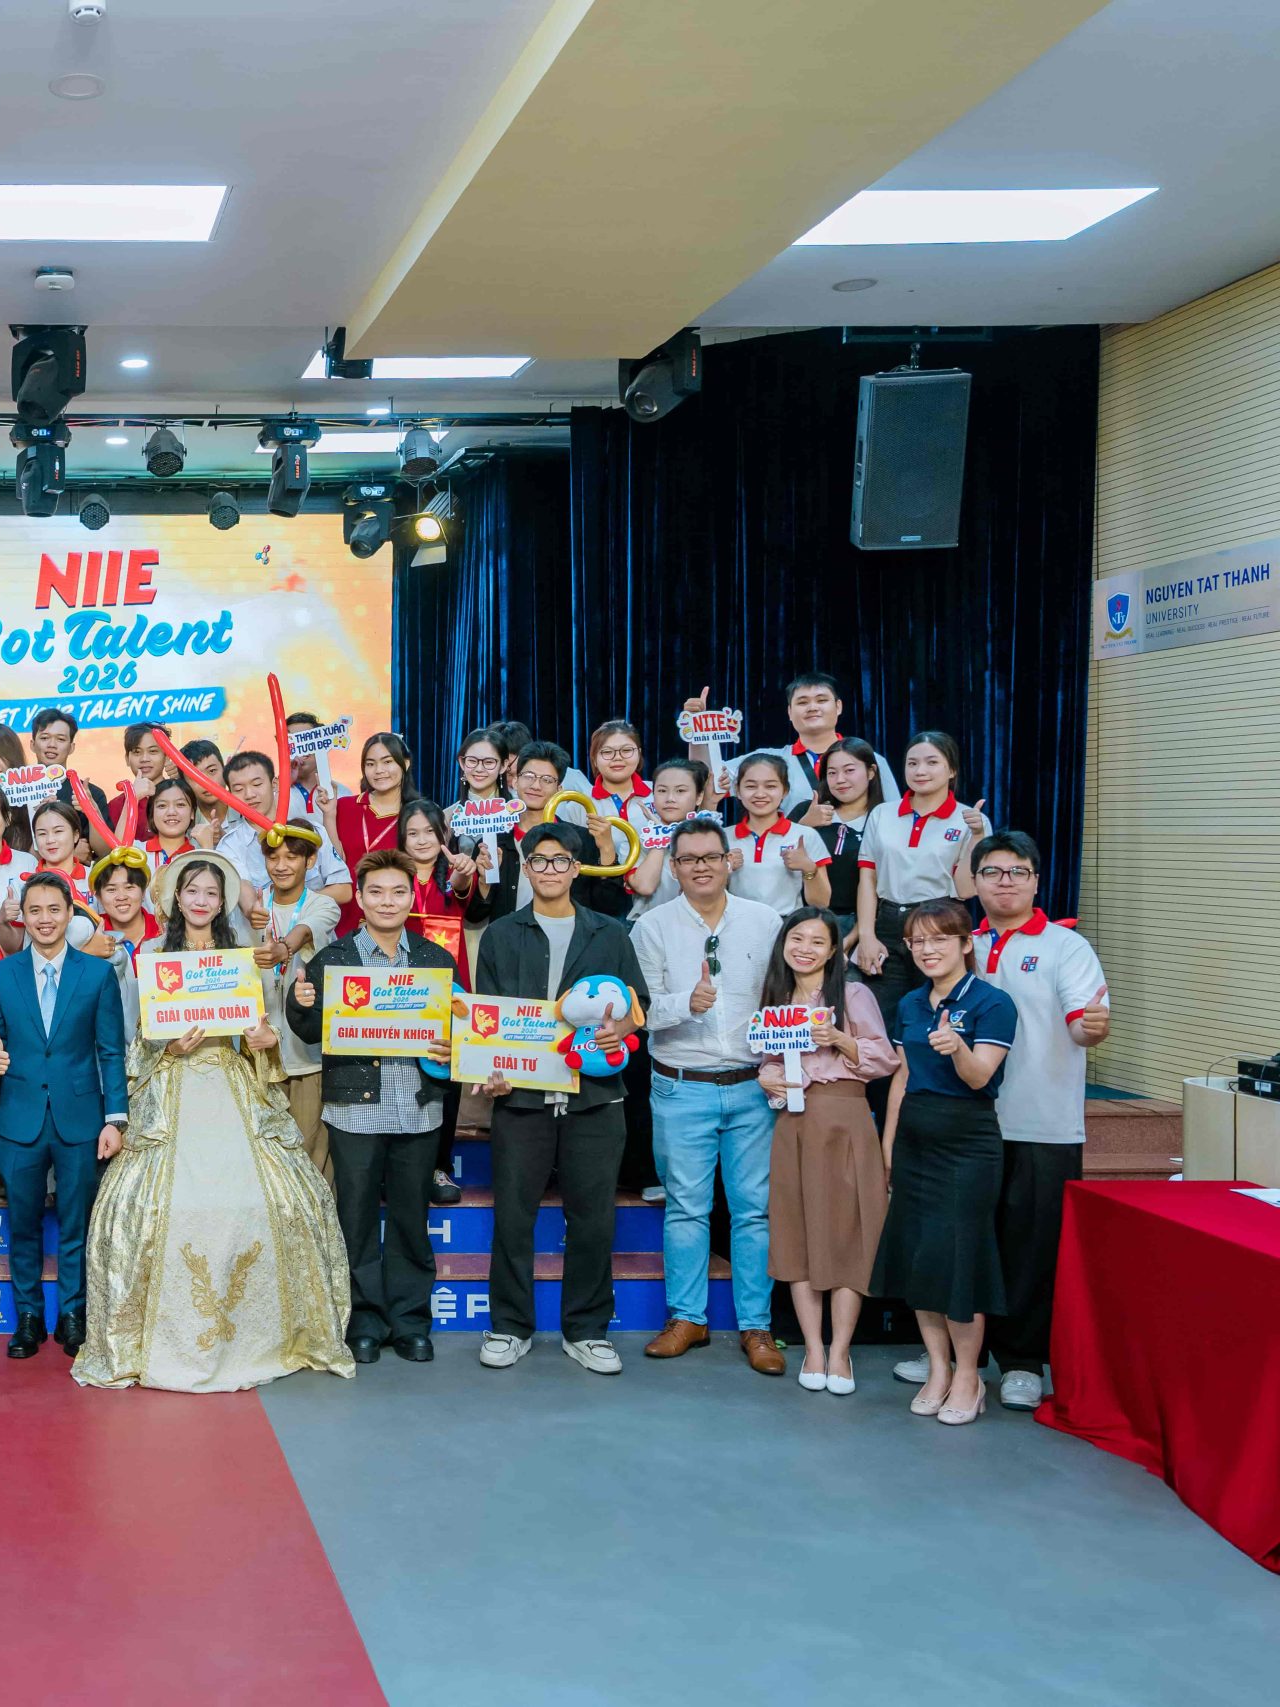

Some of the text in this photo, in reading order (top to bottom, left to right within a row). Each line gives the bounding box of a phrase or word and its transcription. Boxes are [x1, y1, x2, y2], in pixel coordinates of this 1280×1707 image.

[34, 549, 160, 610] NIIE
[1145, 563, 1270, 605] NGUYEN TAT THANH
[1145, 604, 1200, 624] UNIVERSITY
[63, 609, 234, 660] Talent
[57, 660, 138, 694] 2026
[77, 693, 160, 724] TALENT
[159, 692, 217, 717] SHINE
[693, 713, 727, 732] NIIE
[295, 723, 346, 743] THANH XUÂN
[8, 766, 46, 785] NIIE
[35, 781, 60, 791] nhau
[465, 799, 505, 816] NIIE
[472, 816, 491, 826] bên
[493, 814, 519, 824] nhau
[466, 824, 505, 836] bạn nhé
[198, 955, 224, 968] NIIE
[185, 966, 239, 980] Got Talent
[388, 974, 415, 986] NIIE
[373, 986, 430, 997] Got Talent
[156, 1004, 250, 1023] GIẢI QUÁN QUÂN
[517, 1005, 543, 1017] NIIE
[763, 1007, 809, 1028] NIIE
[501, 1017, 558, 1029] Got Talent
[337, 1025, 435, 1040] GIẢI KHUYẾN KHÍCH
[749, 1030, 770, 1041] mãi
[772, 1029, 793, 1040] bên
[765, 1038, 810, 1052] bạn nhé
[493, 1054, 539, 1072] GIẢI TƯ
